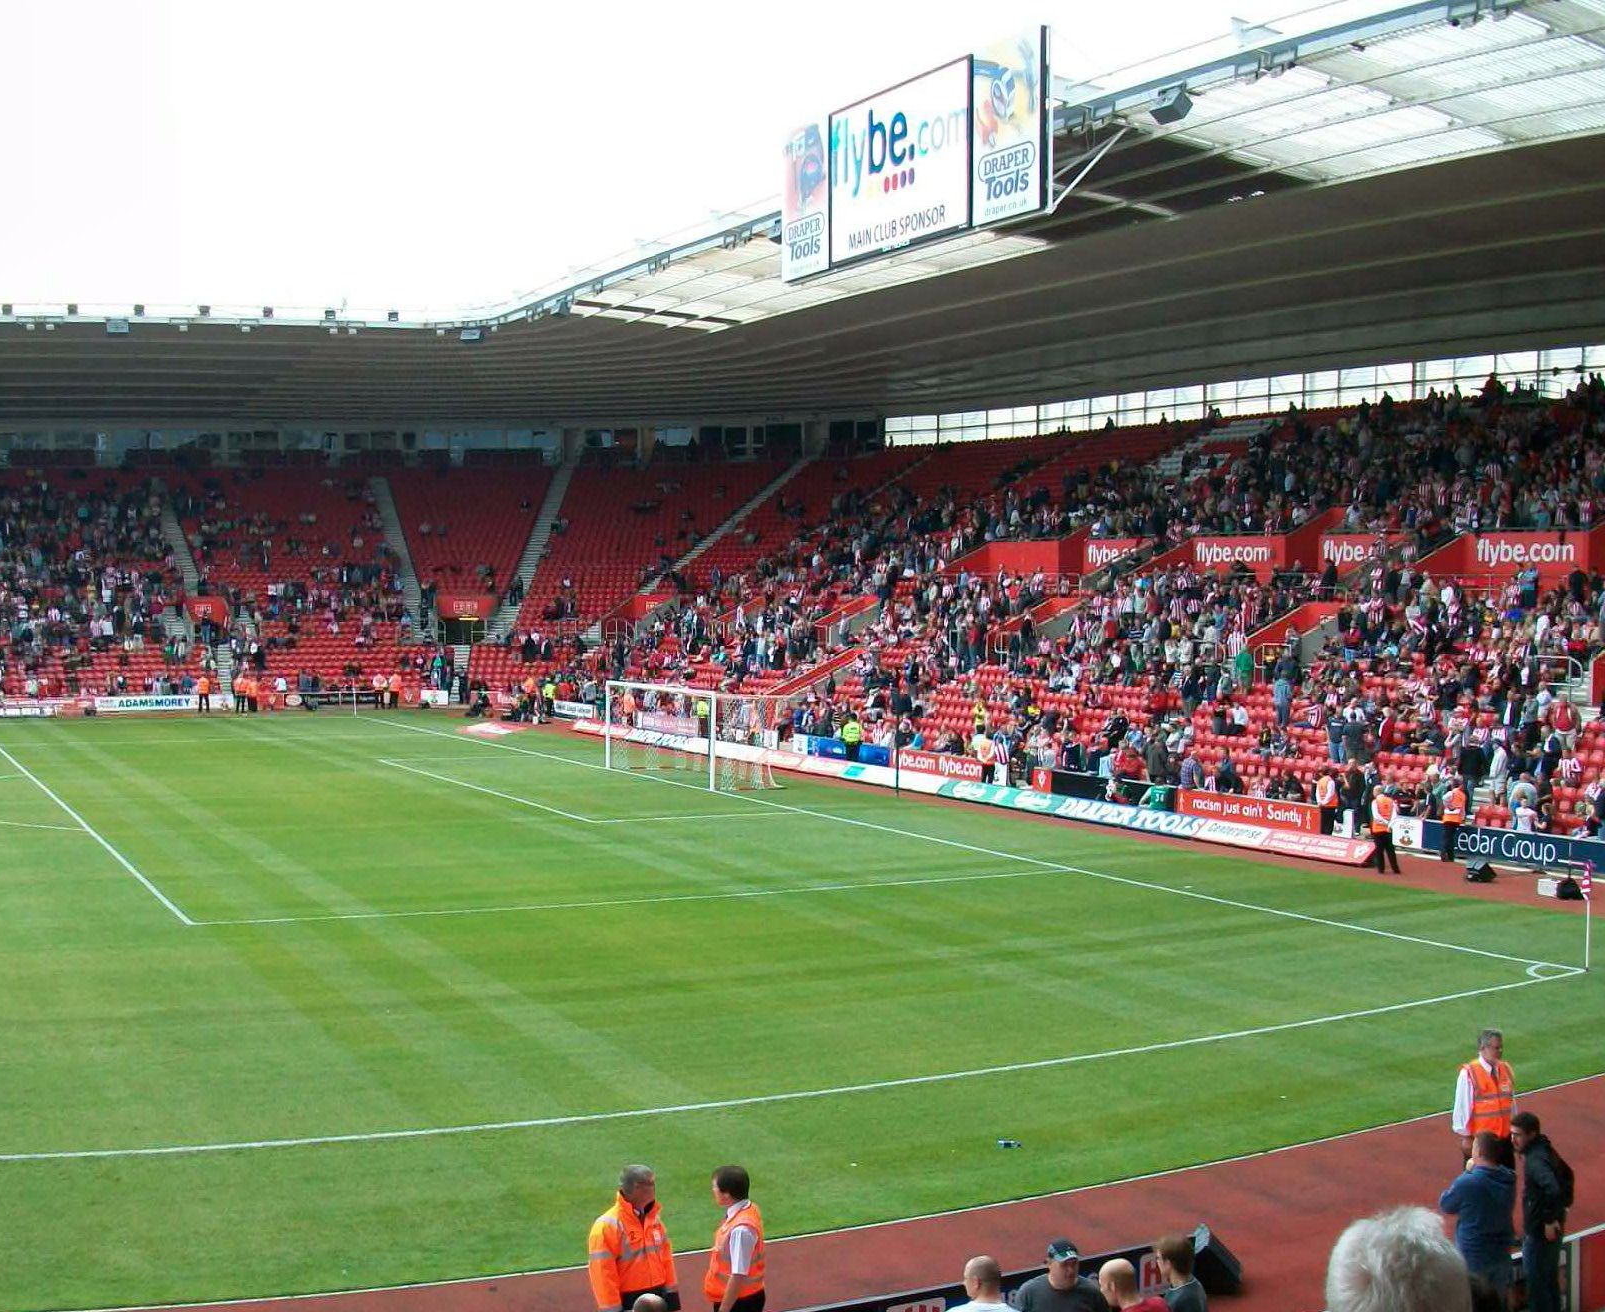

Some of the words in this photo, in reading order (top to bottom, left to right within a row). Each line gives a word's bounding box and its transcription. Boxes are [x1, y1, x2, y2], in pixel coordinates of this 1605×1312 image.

[831, 107, 968, 199] flybe.com
[983, 147, 1030, 177] DRAPER
[985, 170, 1030, 201] Tools
[787, 217, 821, 241] DRAPER
[848, 229, 872, 251] MAIN
[873, 219, 897, 244] CLUB
[899, 204, 946, 237] SPONSOR
[789, 235, 821, 261] Tools
[1196, 541, 1268, 567] flybe.com
[1476, 538, 1575, 567] flybe.com
[118, 697, 191, 707] ADAMSMOREY
[892, 750, 936, 771] fybe.com
[1055, 797, 1139, 826] DRAPER
[1132, 809, 1206, 836] TOOLS
[1192, 797, 1222, 813] racism
[1222, 801, 1240, 816] just
[1242, 803, 1263, 818] ain't
[1267, 805, 1302, 827] Saintly
[1453, 826, 1498, 856] edar
[1501, 832, 1556, 866] Group
